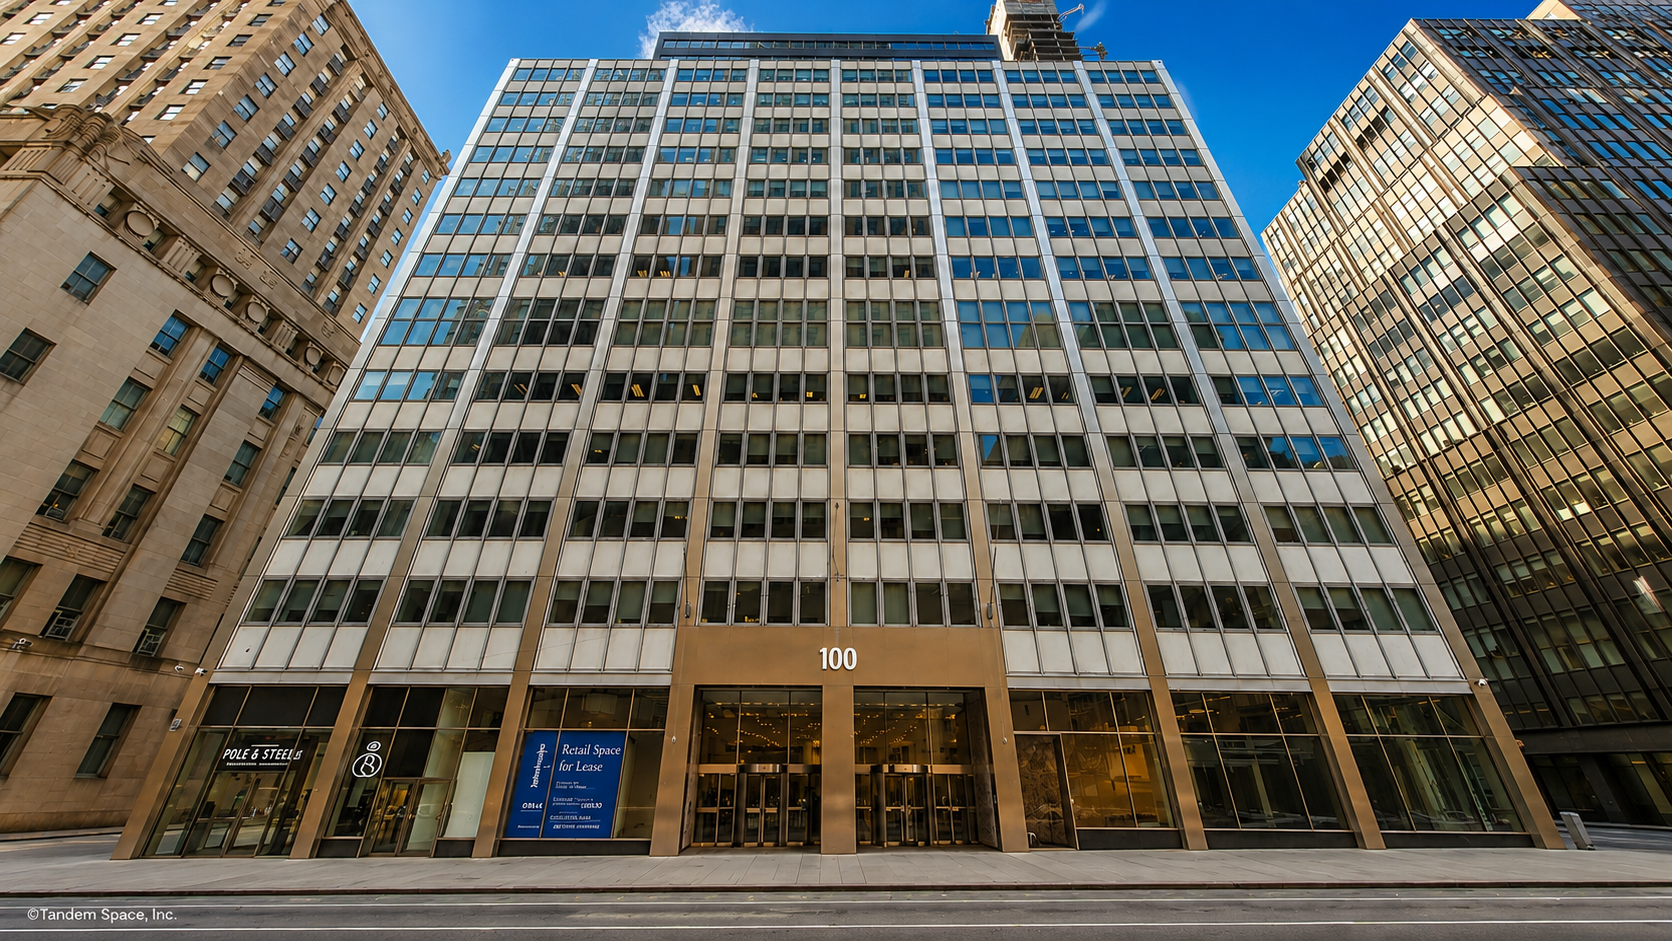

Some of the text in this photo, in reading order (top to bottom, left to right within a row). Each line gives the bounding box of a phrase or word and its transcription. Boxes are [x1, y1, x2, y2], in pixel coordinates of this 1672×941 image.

[819, 647, 858, 670] 100
[222, 748, 251, 760] POLE
[251, 748, 259, 760] &
[562, 743, 621, 758] Retail Space
[559, 759, 603, 772] for Lease
